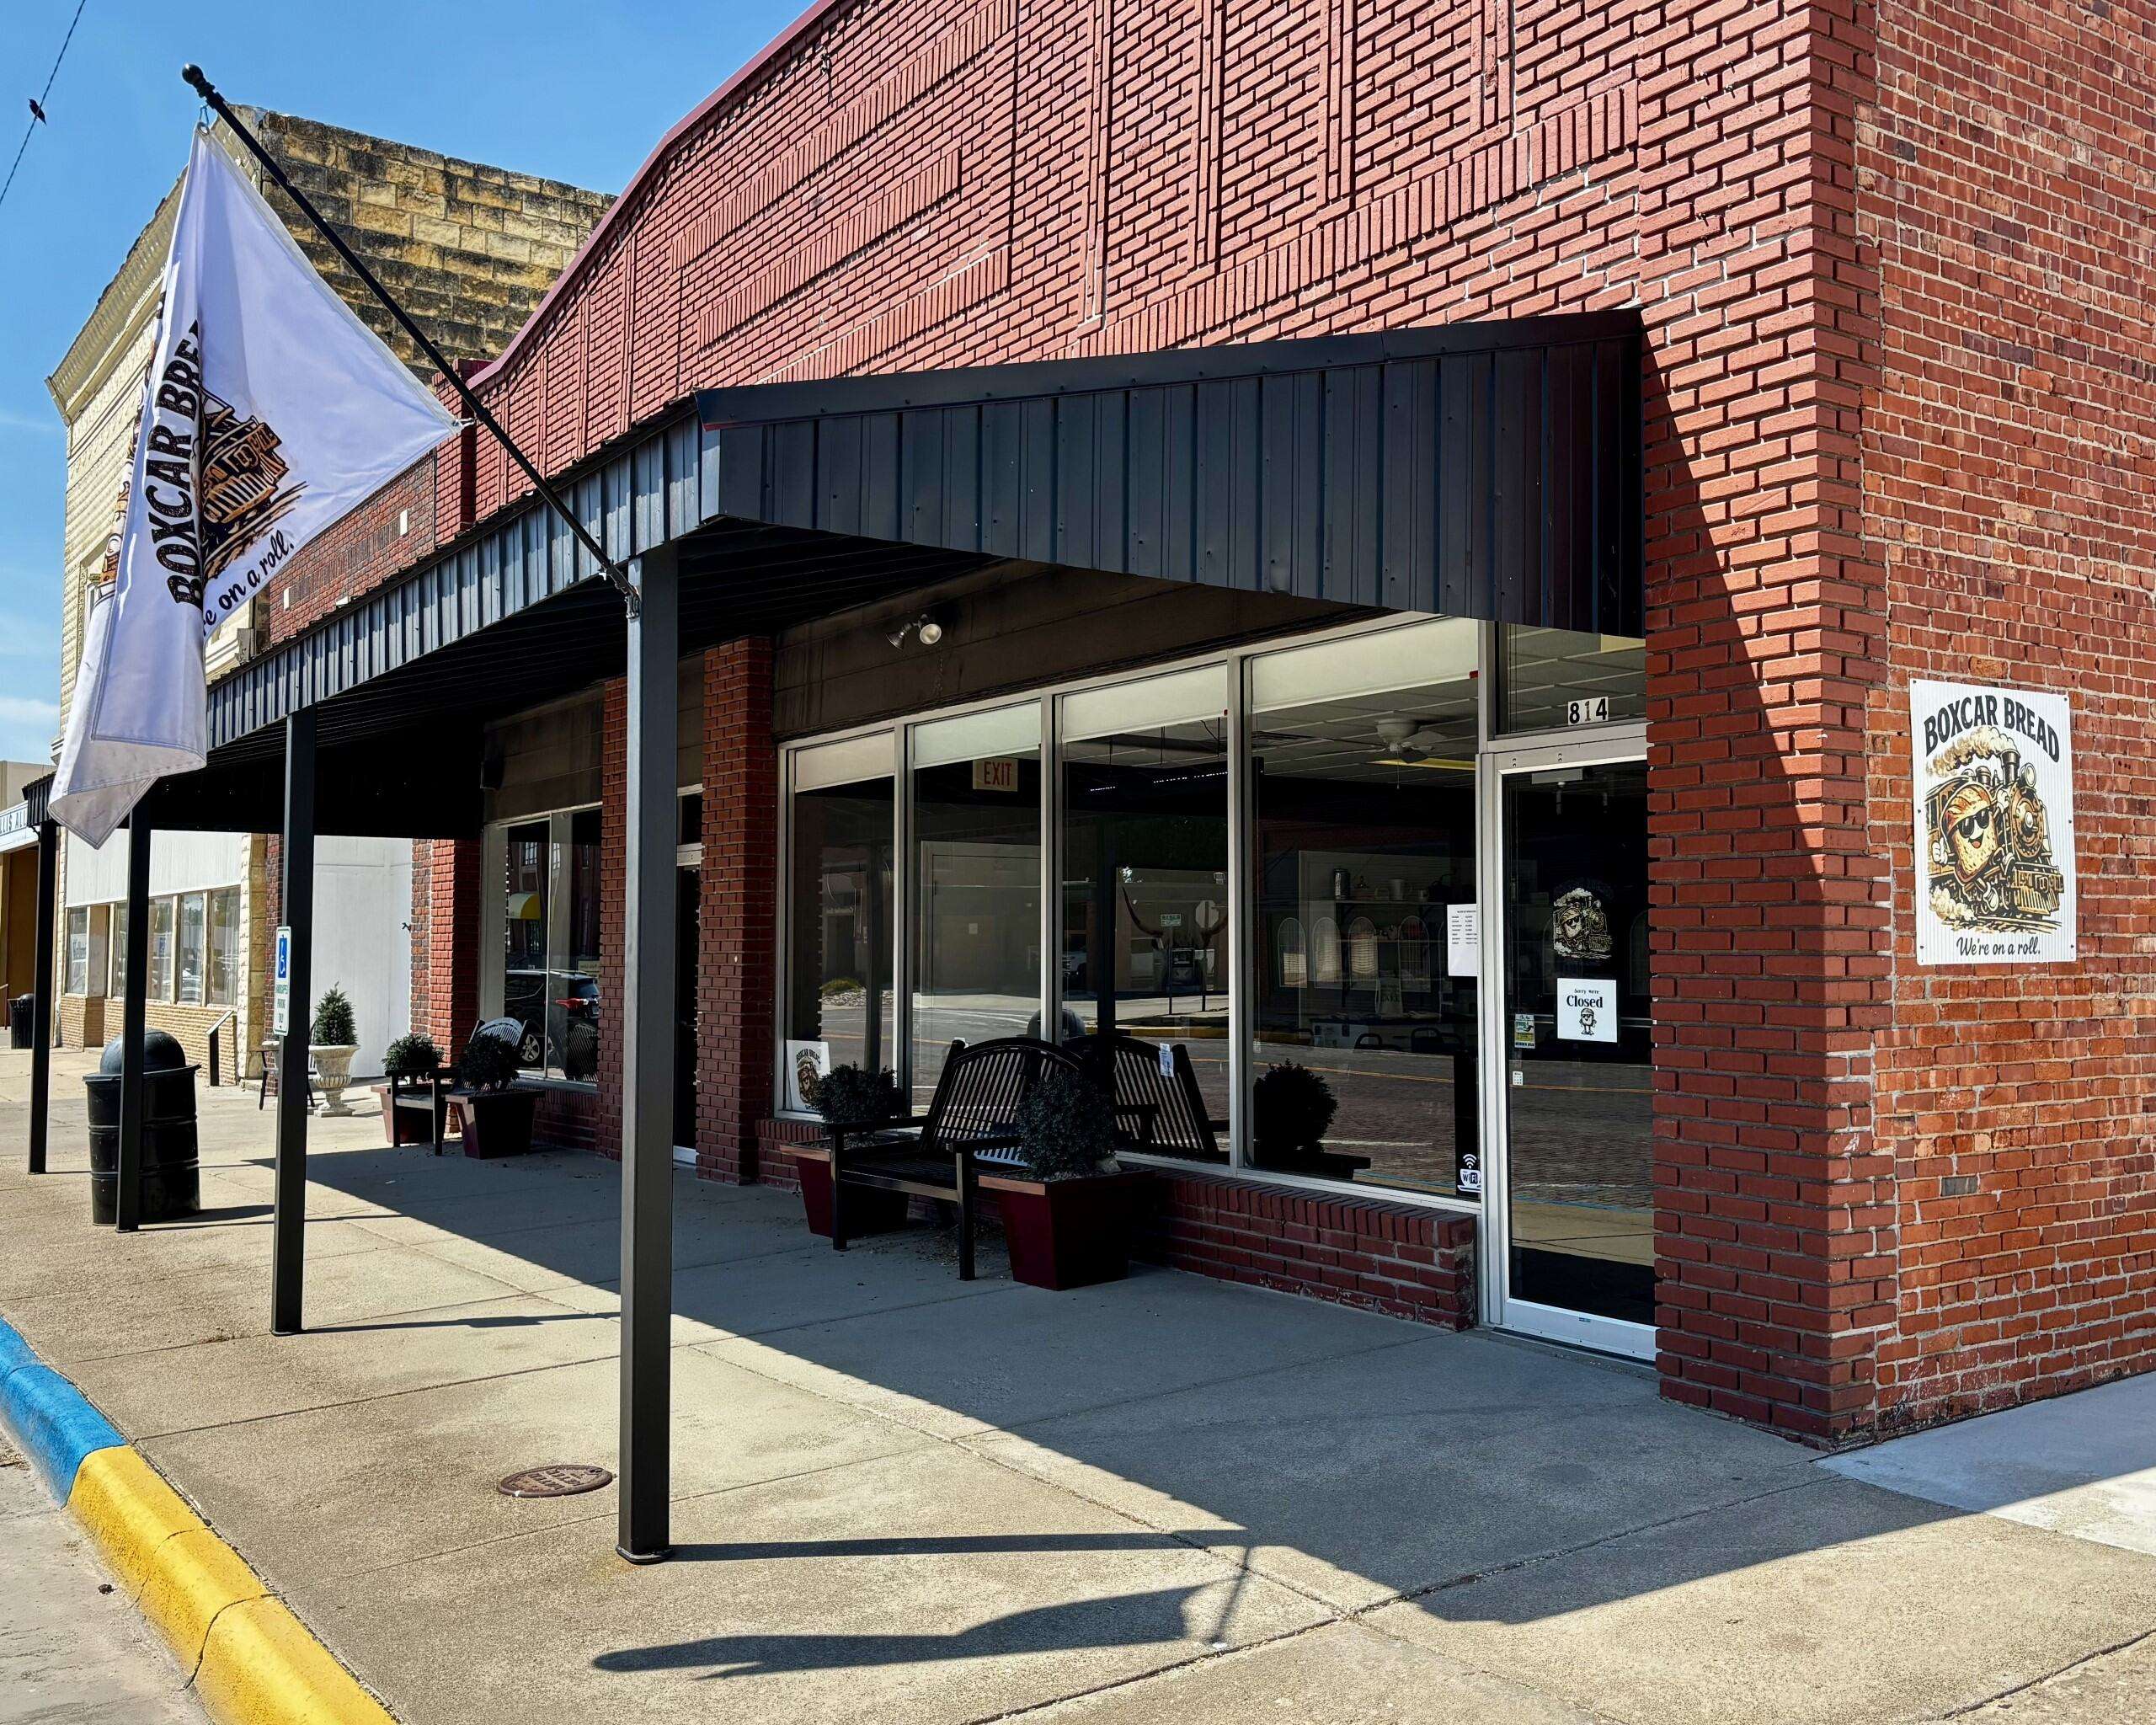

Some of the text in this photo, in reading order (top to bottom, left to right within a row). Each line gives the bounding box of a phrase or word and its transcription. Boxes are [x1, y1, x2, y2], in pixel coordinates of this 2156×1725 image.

[146, 425, 203, 613] BOXCAR
[218, 583, 247, 611] on
[247, 569, 261, 588] a
[259, 529, 295, 576] roll.
[1568, 697, 1608, 724] 814
[1924, 694, 2060, 763] BOXCAR BREAD
[984, 761, 1012, 787] EXIT
[1956, 935, 2041, 957] We're on a roll.
[1566, 995, 1604, 1008] Closed
